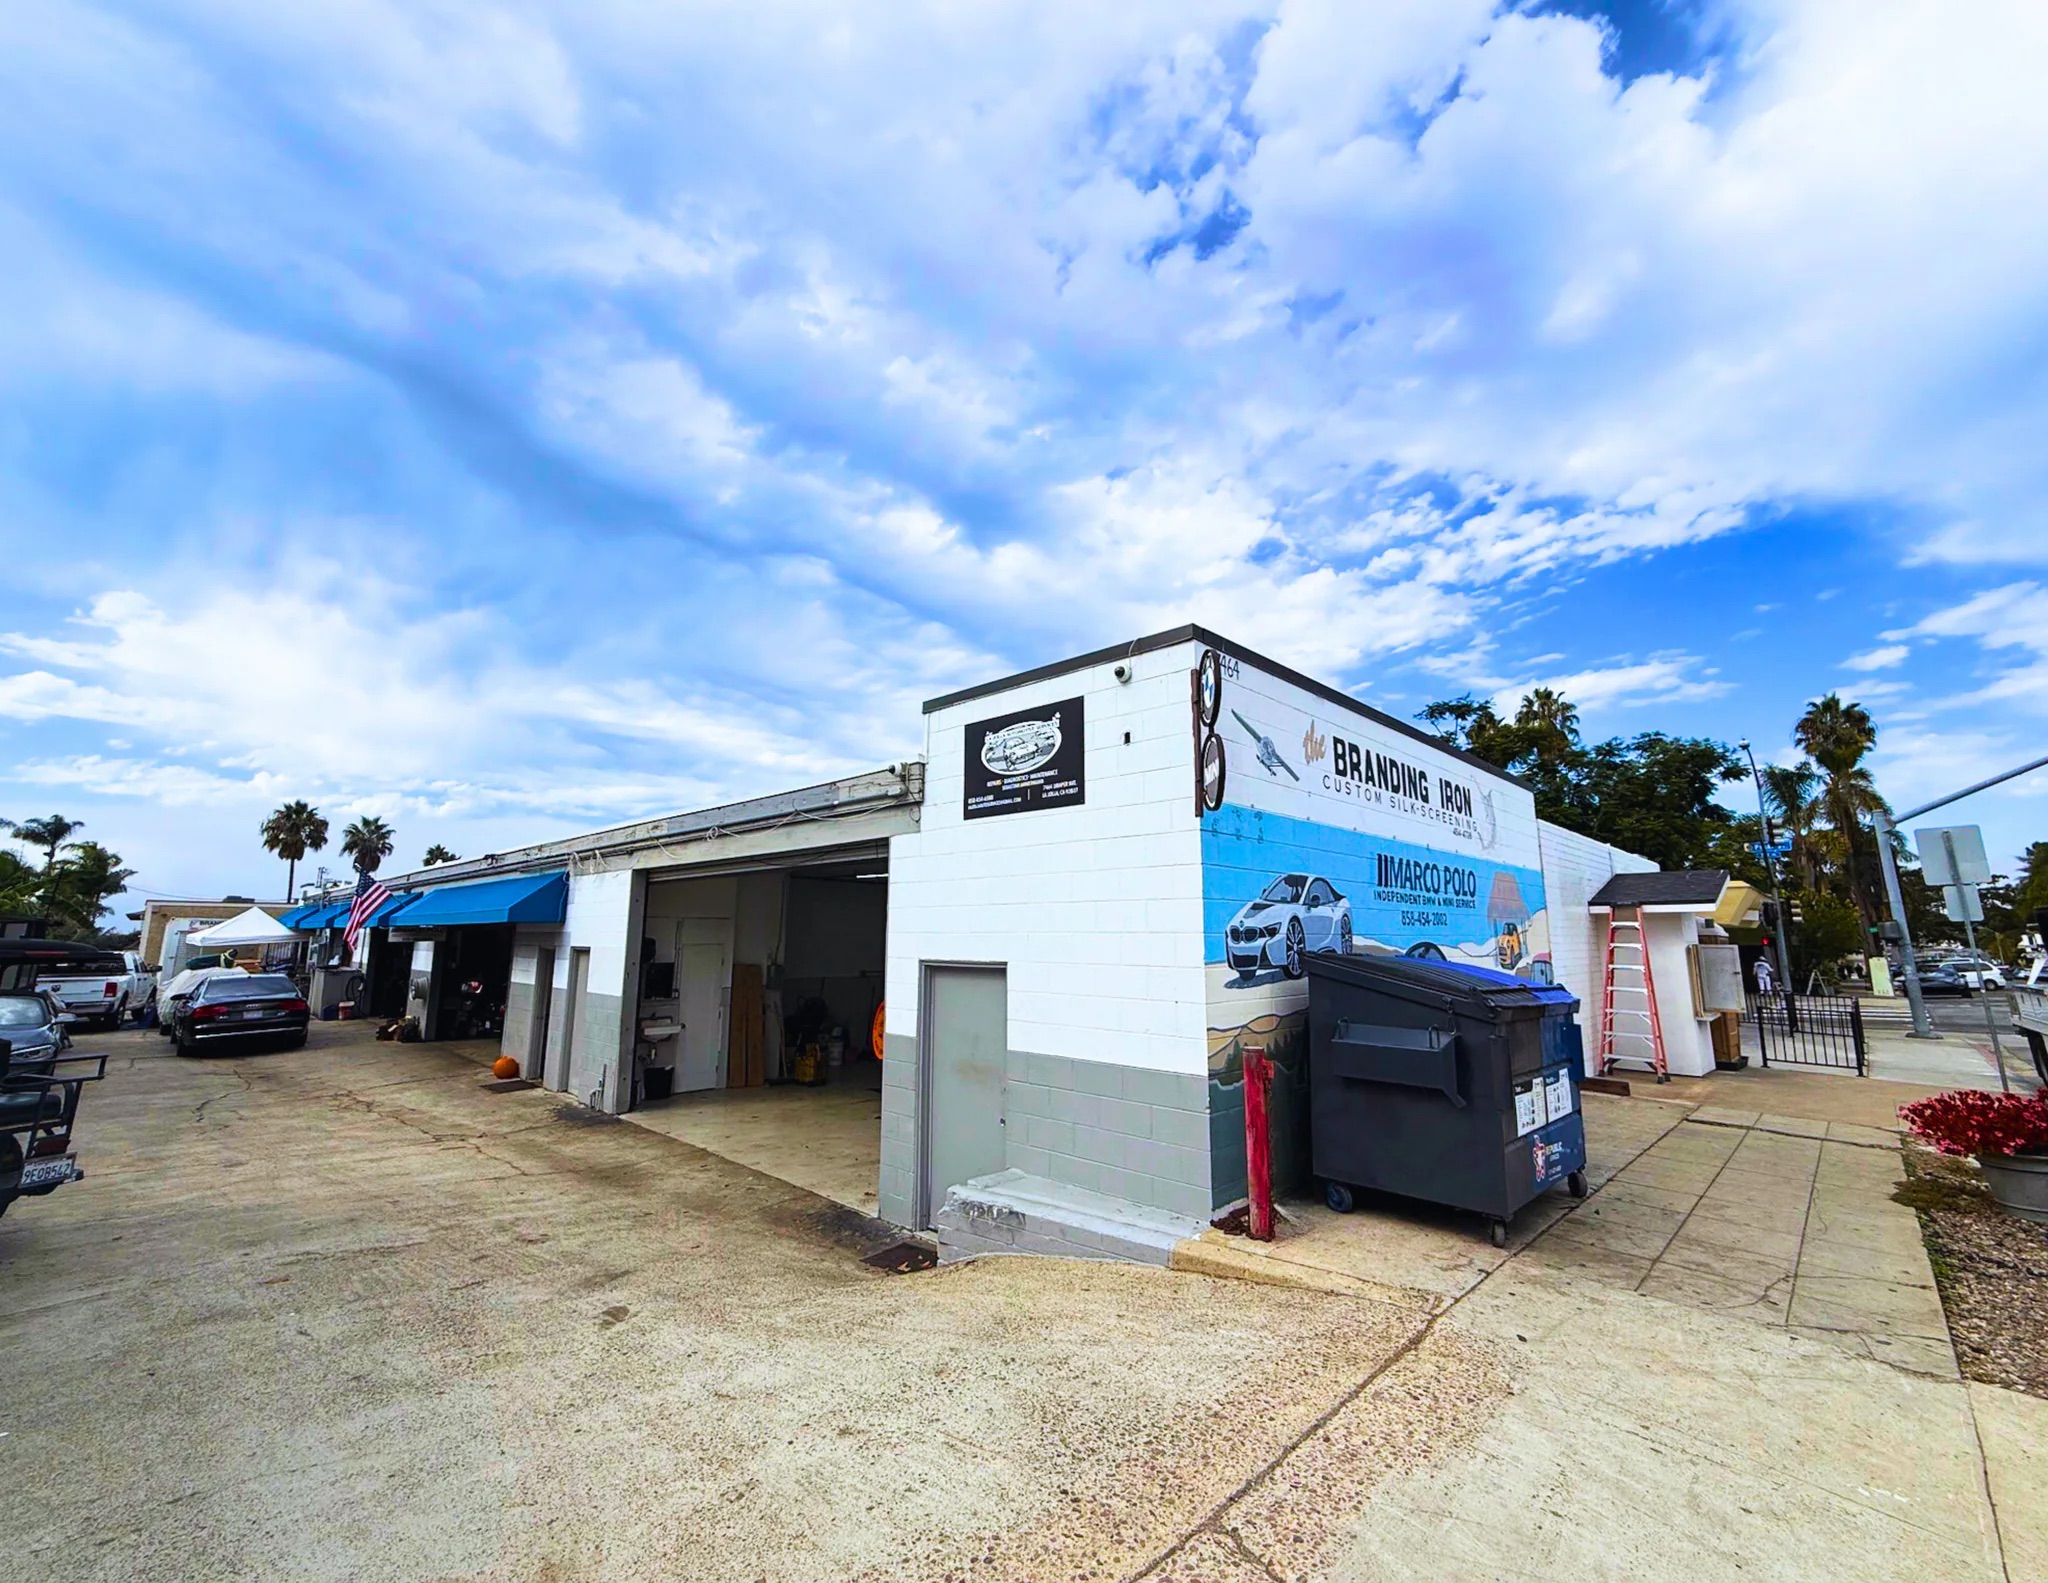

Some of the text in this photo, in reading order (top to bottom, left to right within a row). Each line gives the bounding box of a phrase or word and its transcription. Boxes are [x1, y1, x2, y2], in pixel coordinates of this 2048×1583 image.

[1302, 718, 1326, 764] the
[1332, 735, 1473, 818] BRANDING IRON
[1322, 774, 1478, 832] CUSTOM SILK-SCREENING
[1373, 889, 1421, 905] INDEPENDENT
[1422, 895, 1436, 907] BMW
[1455, 898, 1476, 909] SERVICE
[1389, 855, 1477, 898] MARCO POLO
